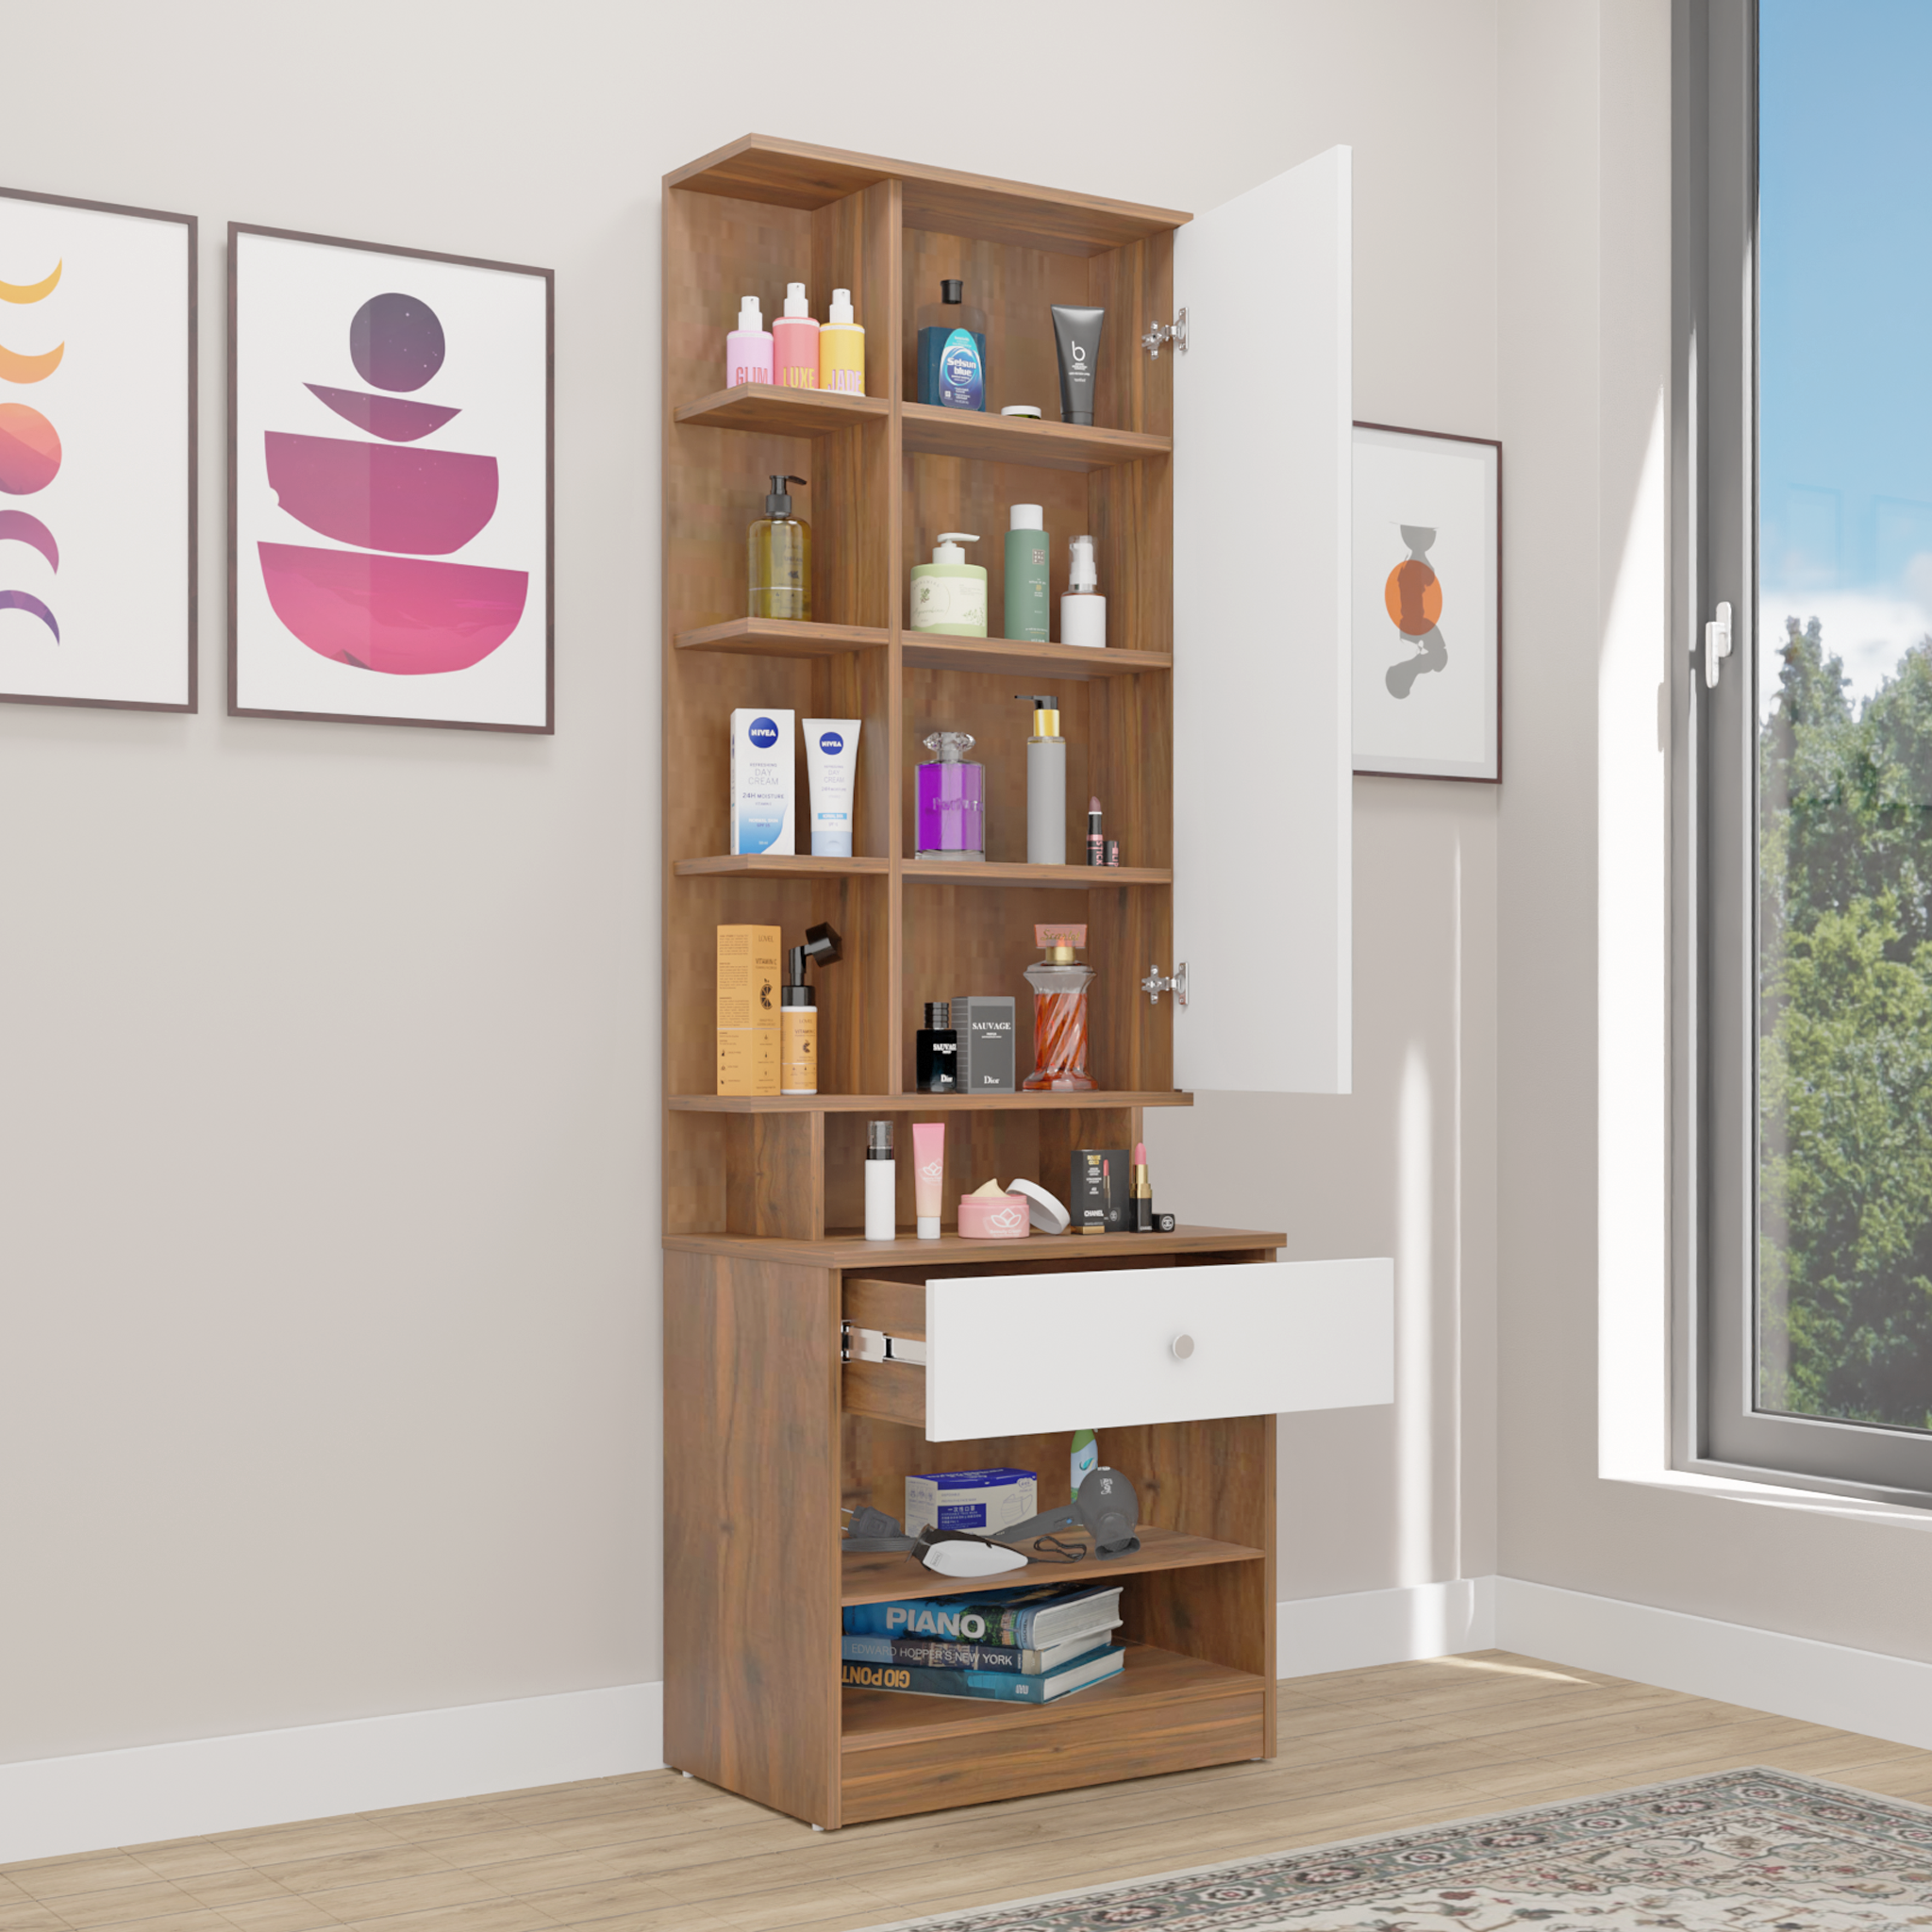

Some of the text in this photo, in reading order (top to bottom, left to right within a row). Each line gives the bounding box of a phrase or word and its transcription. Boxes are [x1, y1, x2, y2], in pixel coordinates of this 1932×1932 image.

[946, 358, 976, 369] Selsun
[954, 366, 973, 376] blue
[783, 366, 815, 389] LUXE
[827, 369, 861, 392] JADE
[1041, 929, 1080, 941] Scarlet
[984, 1075, 1000, 1084] Dior
[886, 1607, 986, 1639] PIANO
[852, 1643, 1012, 1666] EDWARD HOPPER'S NEW YORK
[884, 1669, 910, 1689] GIO
